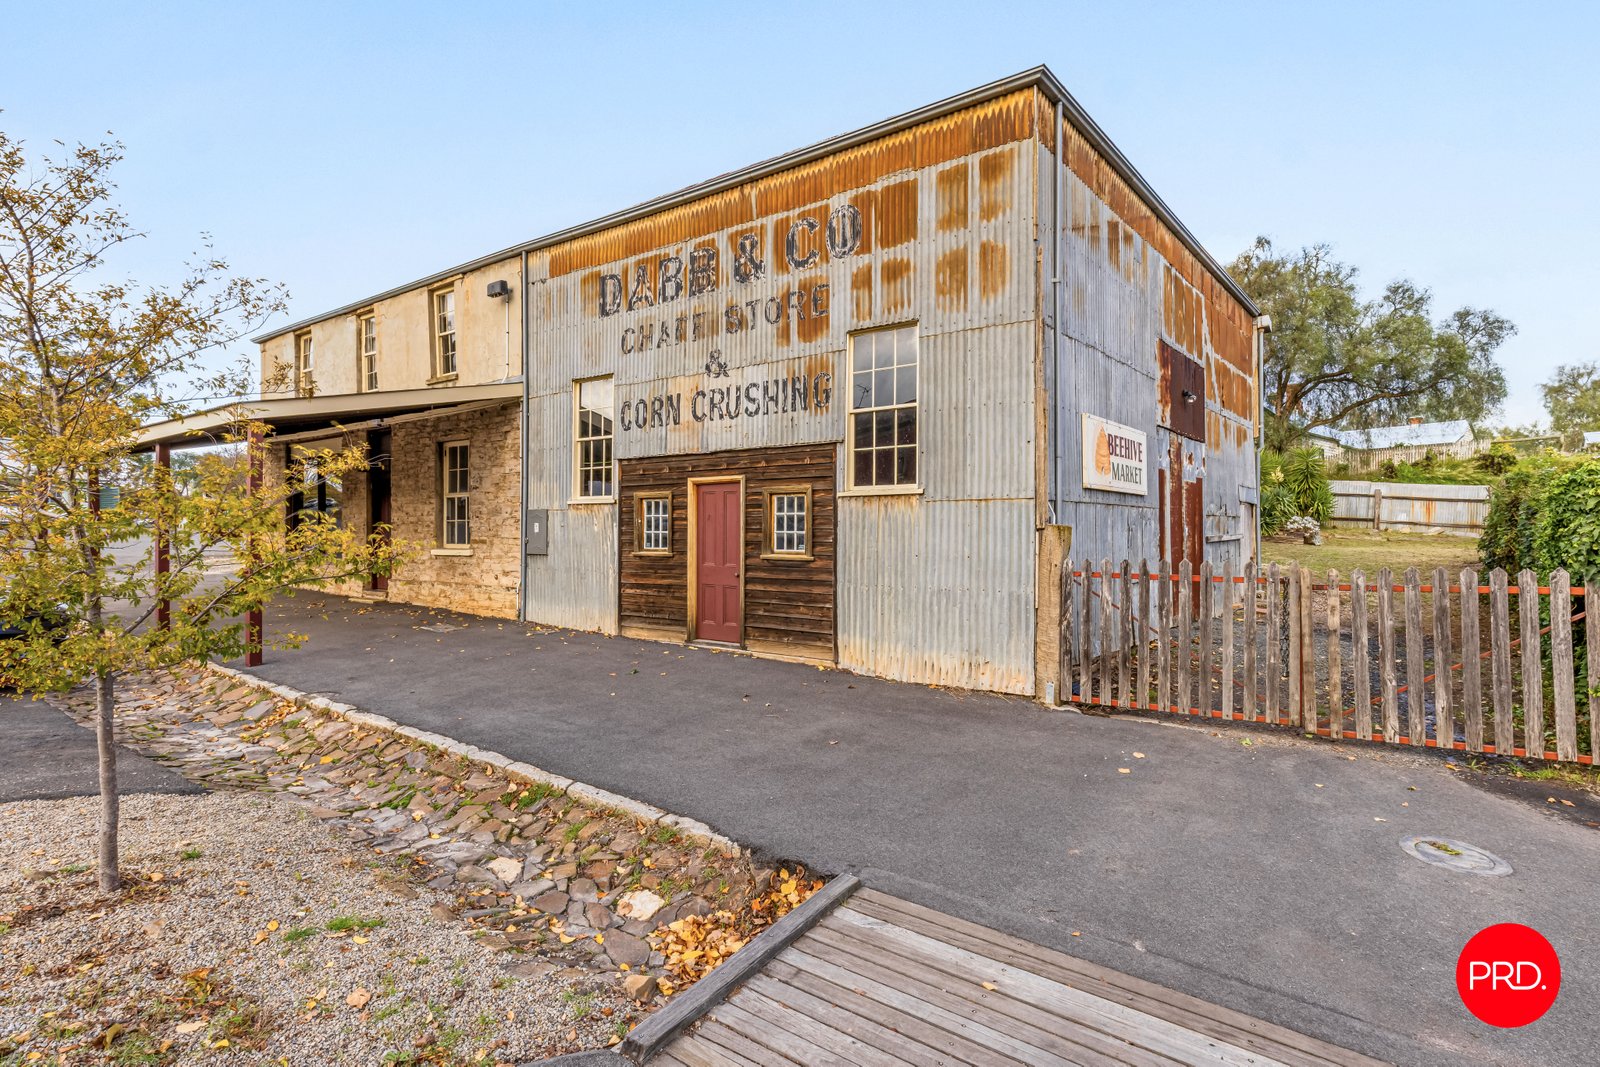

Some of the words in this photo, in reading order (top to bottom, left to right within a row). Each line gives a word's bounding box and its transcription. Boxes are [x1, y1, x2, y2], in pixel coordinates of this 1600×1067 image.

[599, 248, 717, 318] DABB
[733, 233, 766, 284] &
[785, 204, 862, 270] CO
[724, 284, 830, 334] STORE
[704, 349, 729, 379] &
[620, 392, 681, 432] CORN
[691, 372, 832, 422] CRUSHING
[1107, 433, 1142, 462] BEEHIVE
[1111, 462, 1142, 485] MARKET
